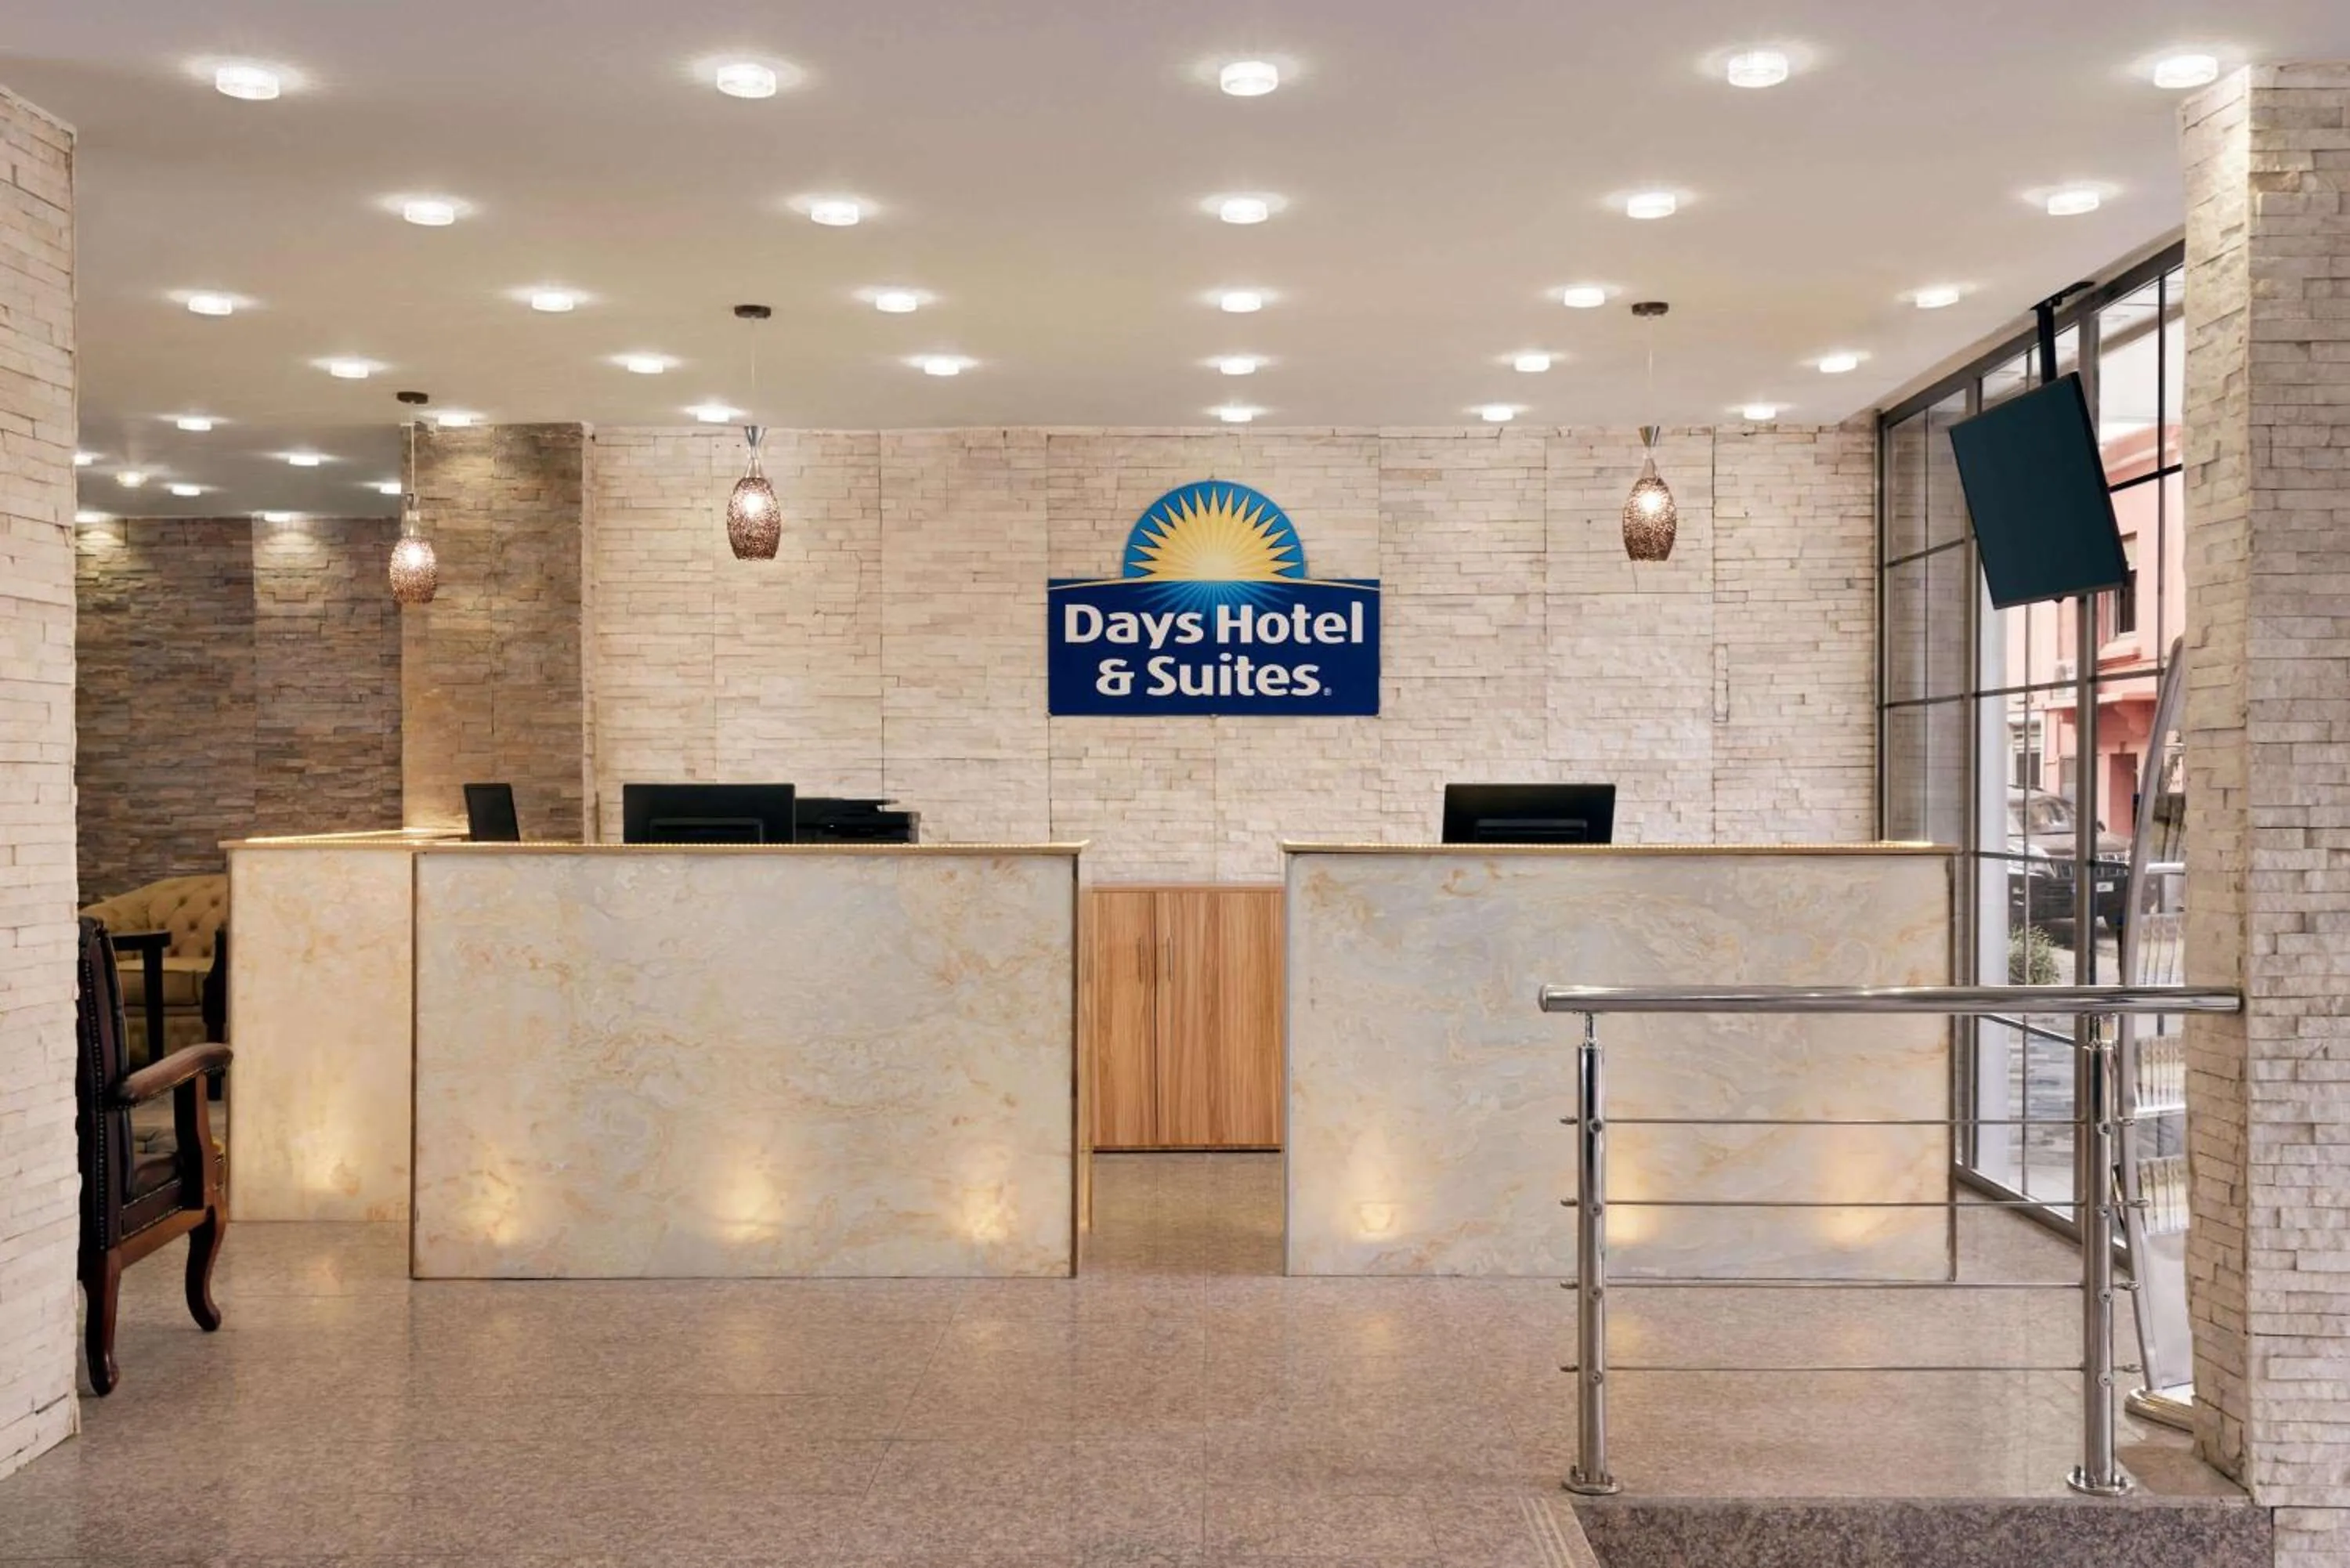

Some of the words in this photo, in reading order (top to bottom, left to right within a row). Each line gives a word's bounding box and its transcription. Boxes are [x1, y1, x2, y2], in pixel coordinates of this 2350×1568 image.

[1064, 604, 1204, 649] Days
[1217, 601, 1364, 644] Hotel
[1096, 659, 1135, 696] &
